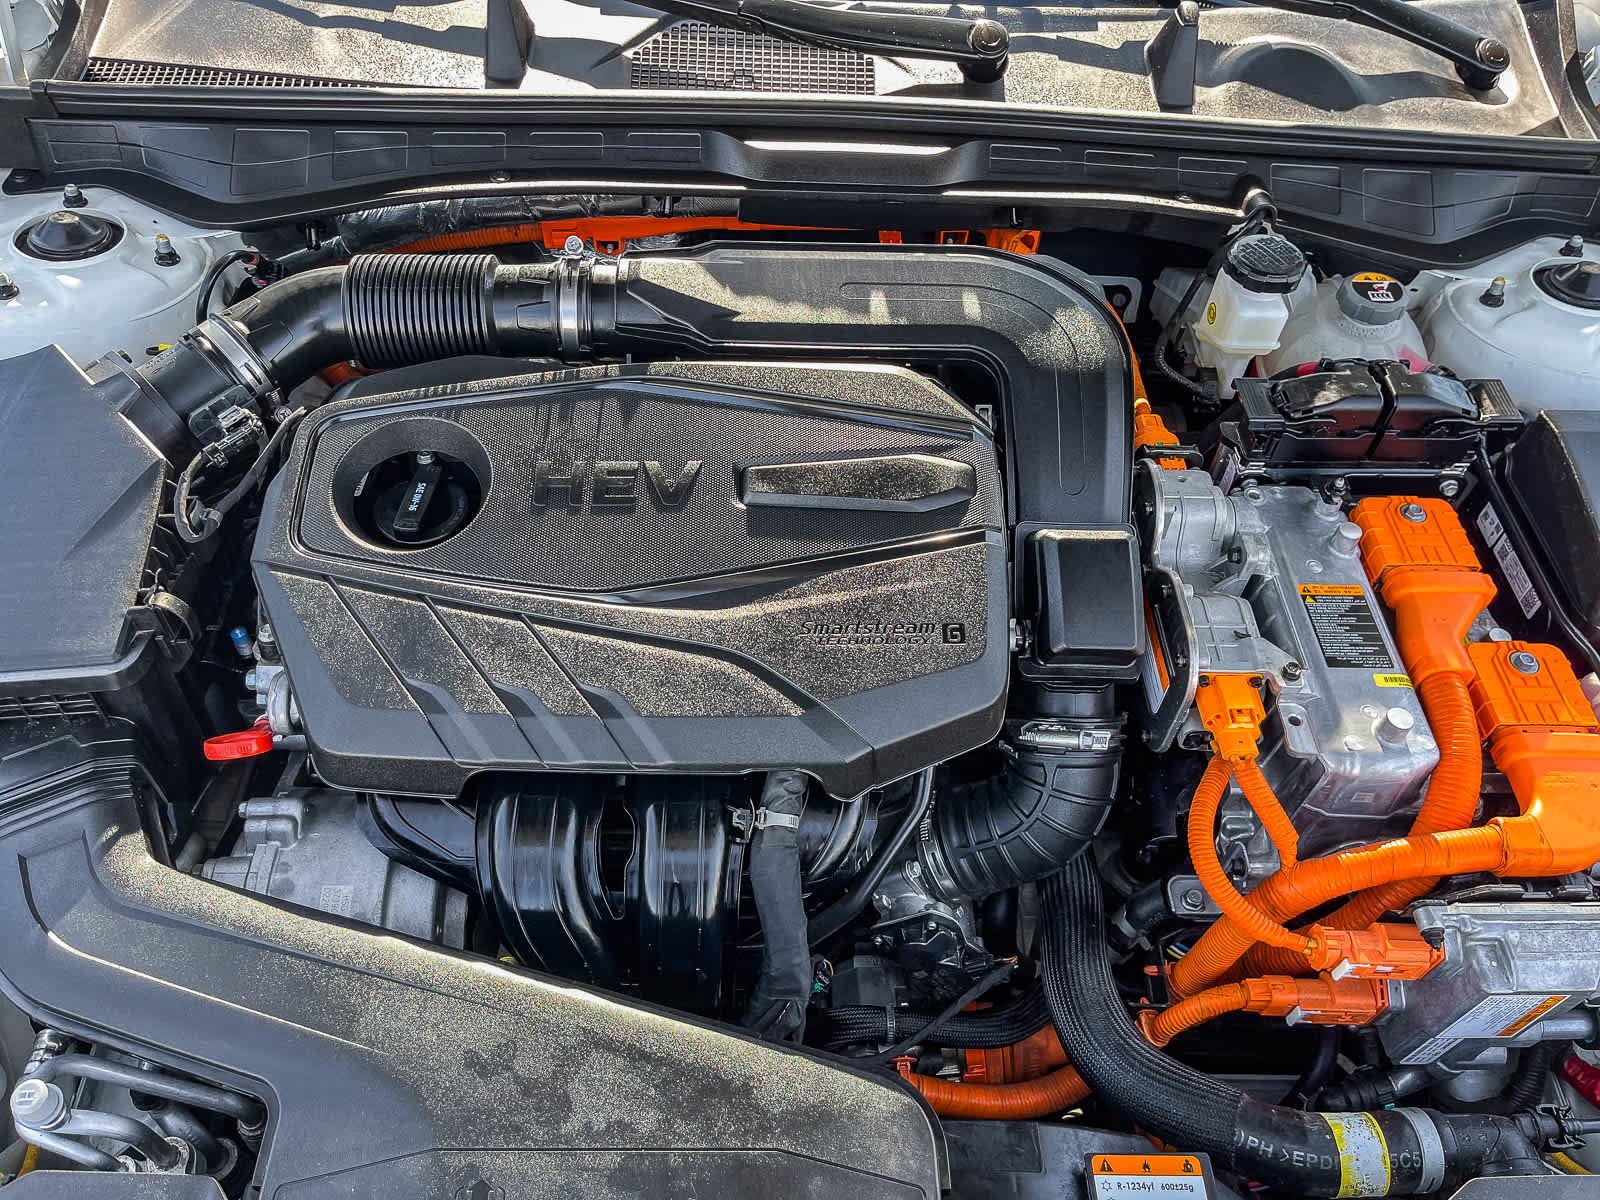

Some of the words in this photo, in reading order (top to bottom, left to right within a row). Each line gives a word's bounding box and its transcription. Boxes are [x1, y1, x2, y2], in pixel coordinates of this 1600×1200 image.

[533, 460, 702, 507] HEV
[801, 620, 936, 635] Smartstream
[943, 623, 966, 643] G
[1390, 1151, 1421, 1169] 5C5
[1160, 1183, 1194, 1192] 600±25g
